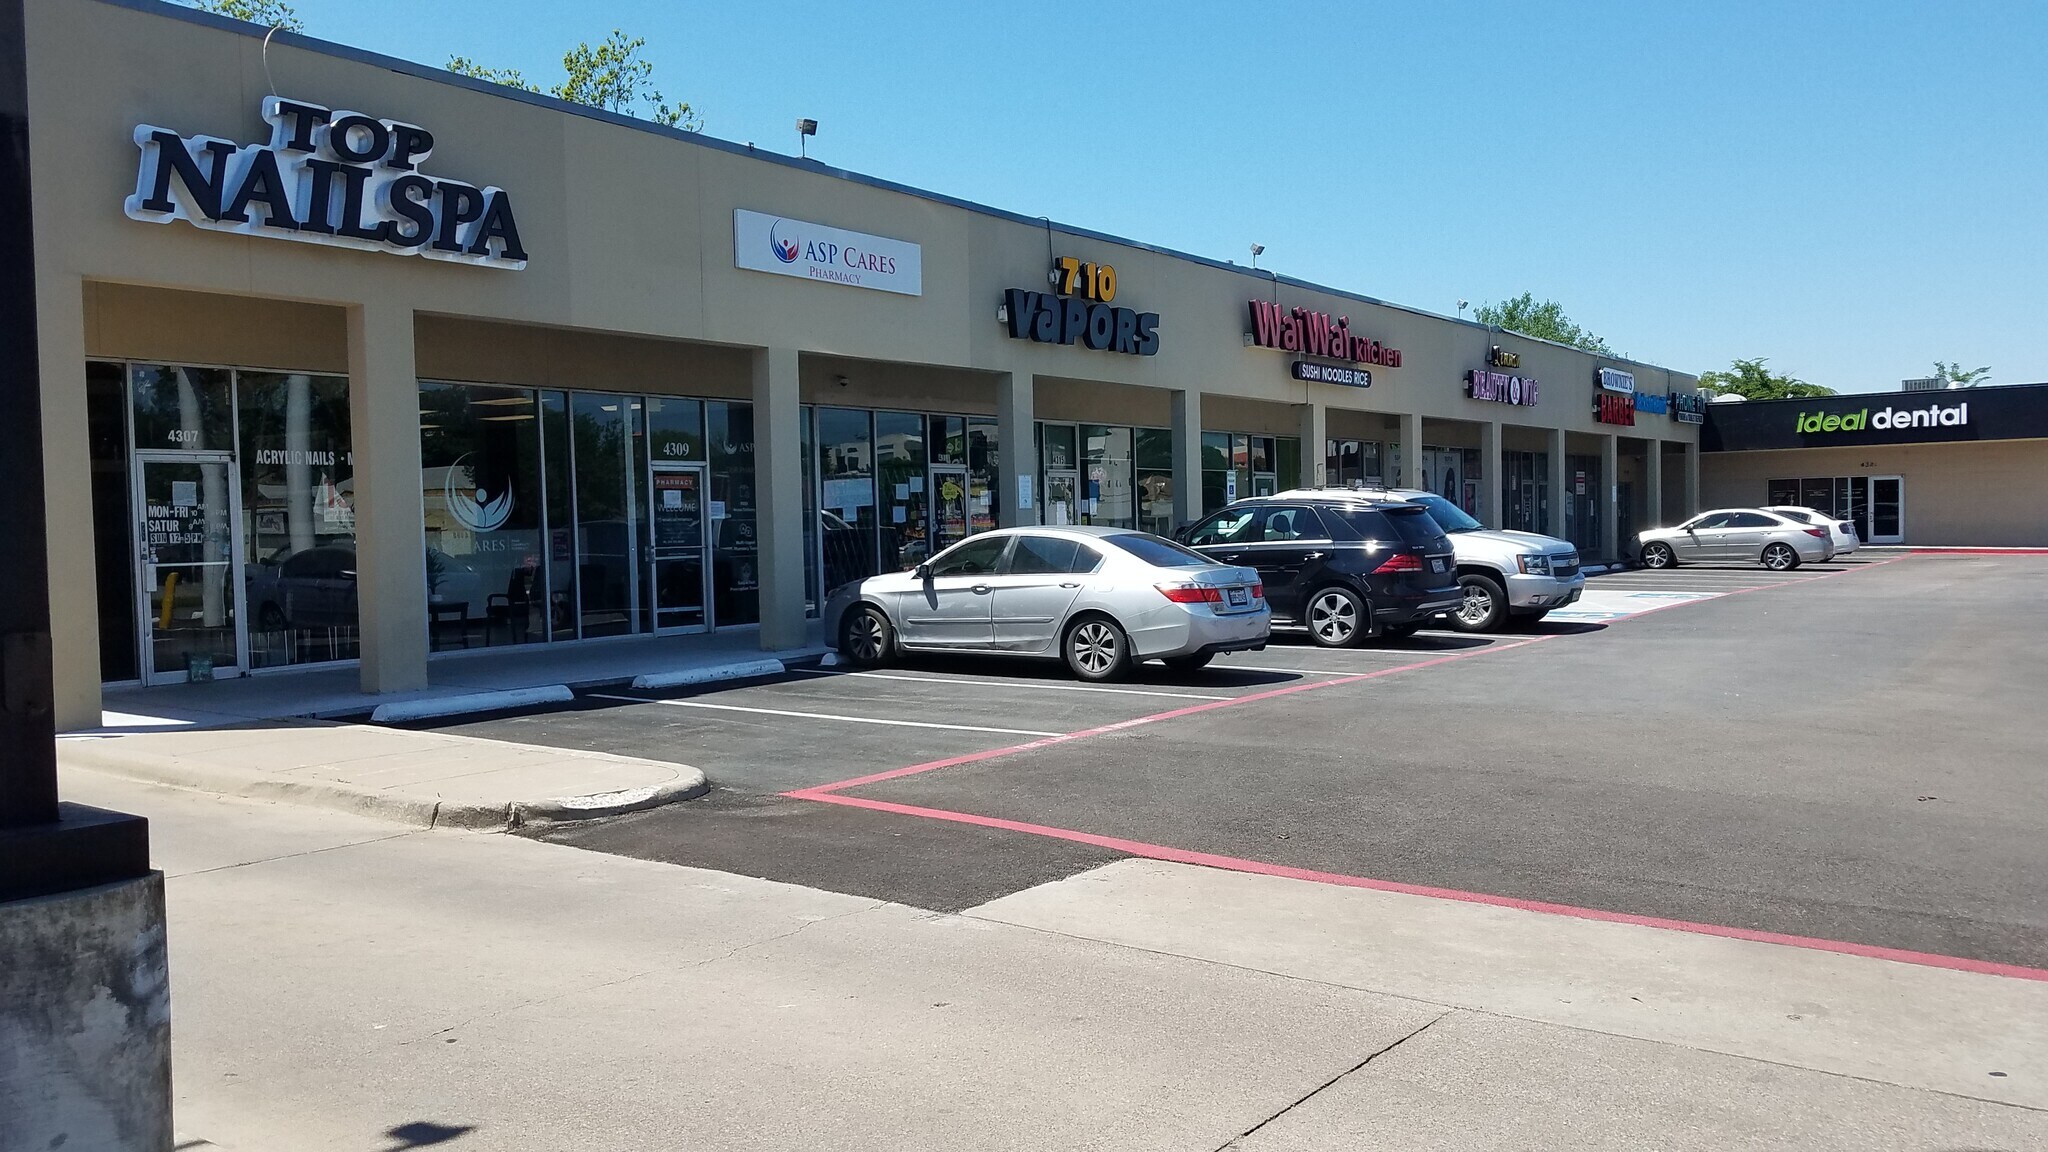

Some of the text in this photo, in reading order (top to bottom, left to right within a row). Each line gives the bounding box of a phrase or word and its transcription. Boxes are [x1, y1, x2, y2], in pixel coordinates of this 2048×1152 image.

[276, 100, 434, 170] TOP
[804, 240, 896, 274] ASP CARES
[809, 265, 861, 284] PHARMACY
[1353, 335, 1403, 368] kitchen
[1302, 363, 1368, 386] SUSHI NOODLES RICE
[1472, 369, 1510, 403] BEAUTY
[1601, 393, 1636, 426] BARBER
[1796, 403, 1968, 433] ideal dental
[167, 429, 199, 443] 4307
[256, 449, 302, 465] ACRYLIC
[305, 450, 335, 466] NAILS
[662, 442, 690, 456] 4309
[148, 505, 189, 518] MON-FRI
[148, 519, 180, 532] SATUR
